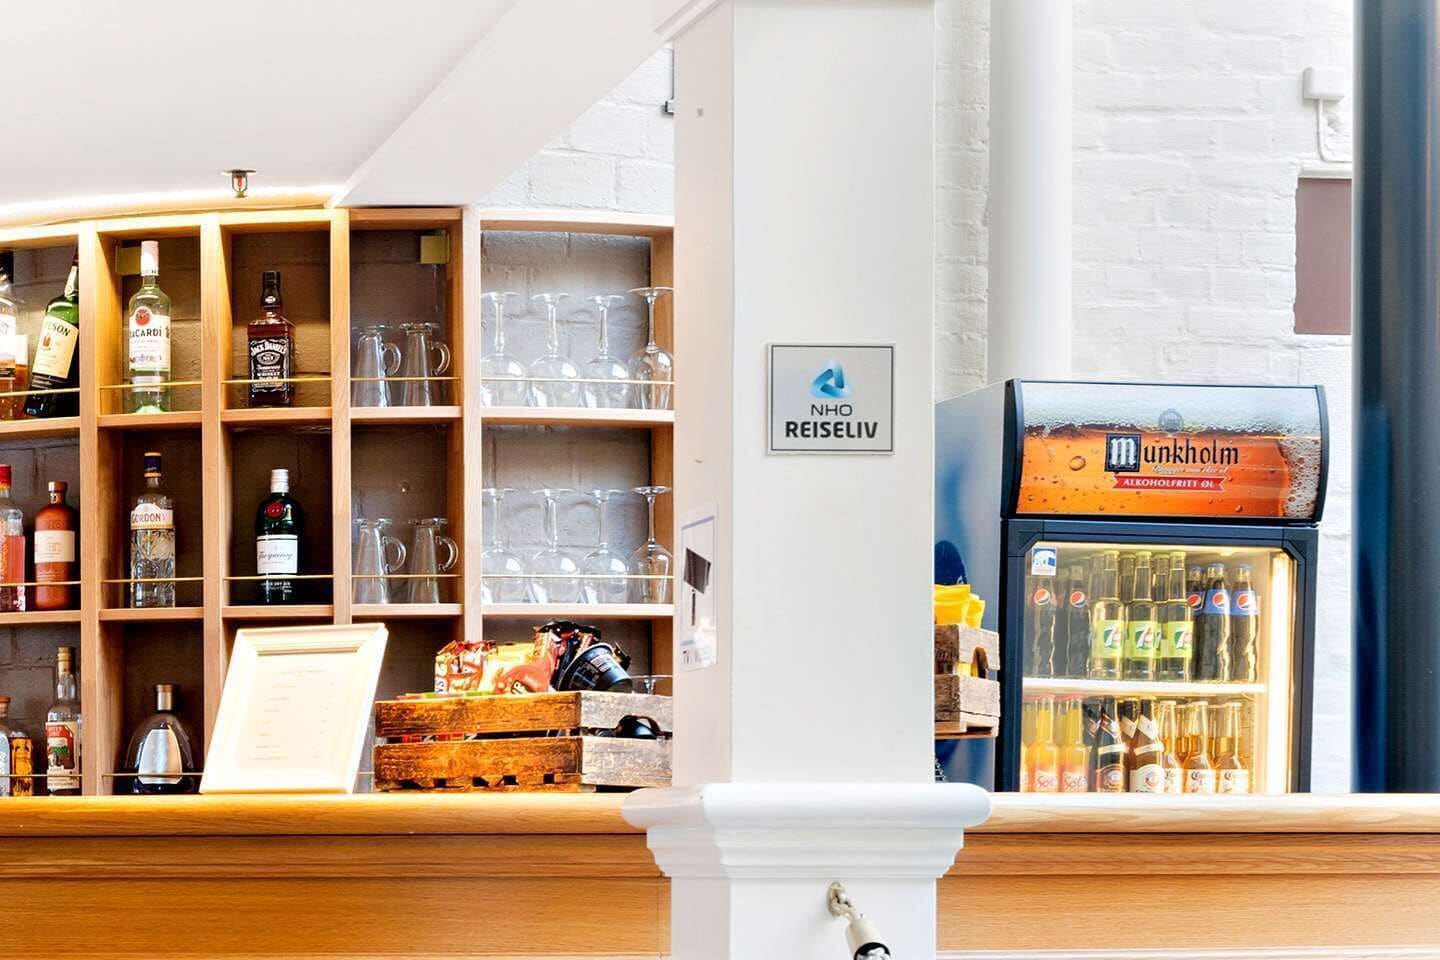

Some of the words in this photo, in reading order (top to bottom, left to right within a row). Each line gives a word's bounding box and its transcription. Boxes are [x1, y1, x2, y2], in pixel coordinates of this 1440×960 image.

[250, 343, 265, 356] JACK
[810, 404, 853, 416] NHO
[785, 421, 878, 438] REISELIV
[1111, 437, 1239, 466] Munkholm
[1123, 479, 1197, 488] ALKOHOLFRITT
[1200, 480, 1215, 488] ØL
